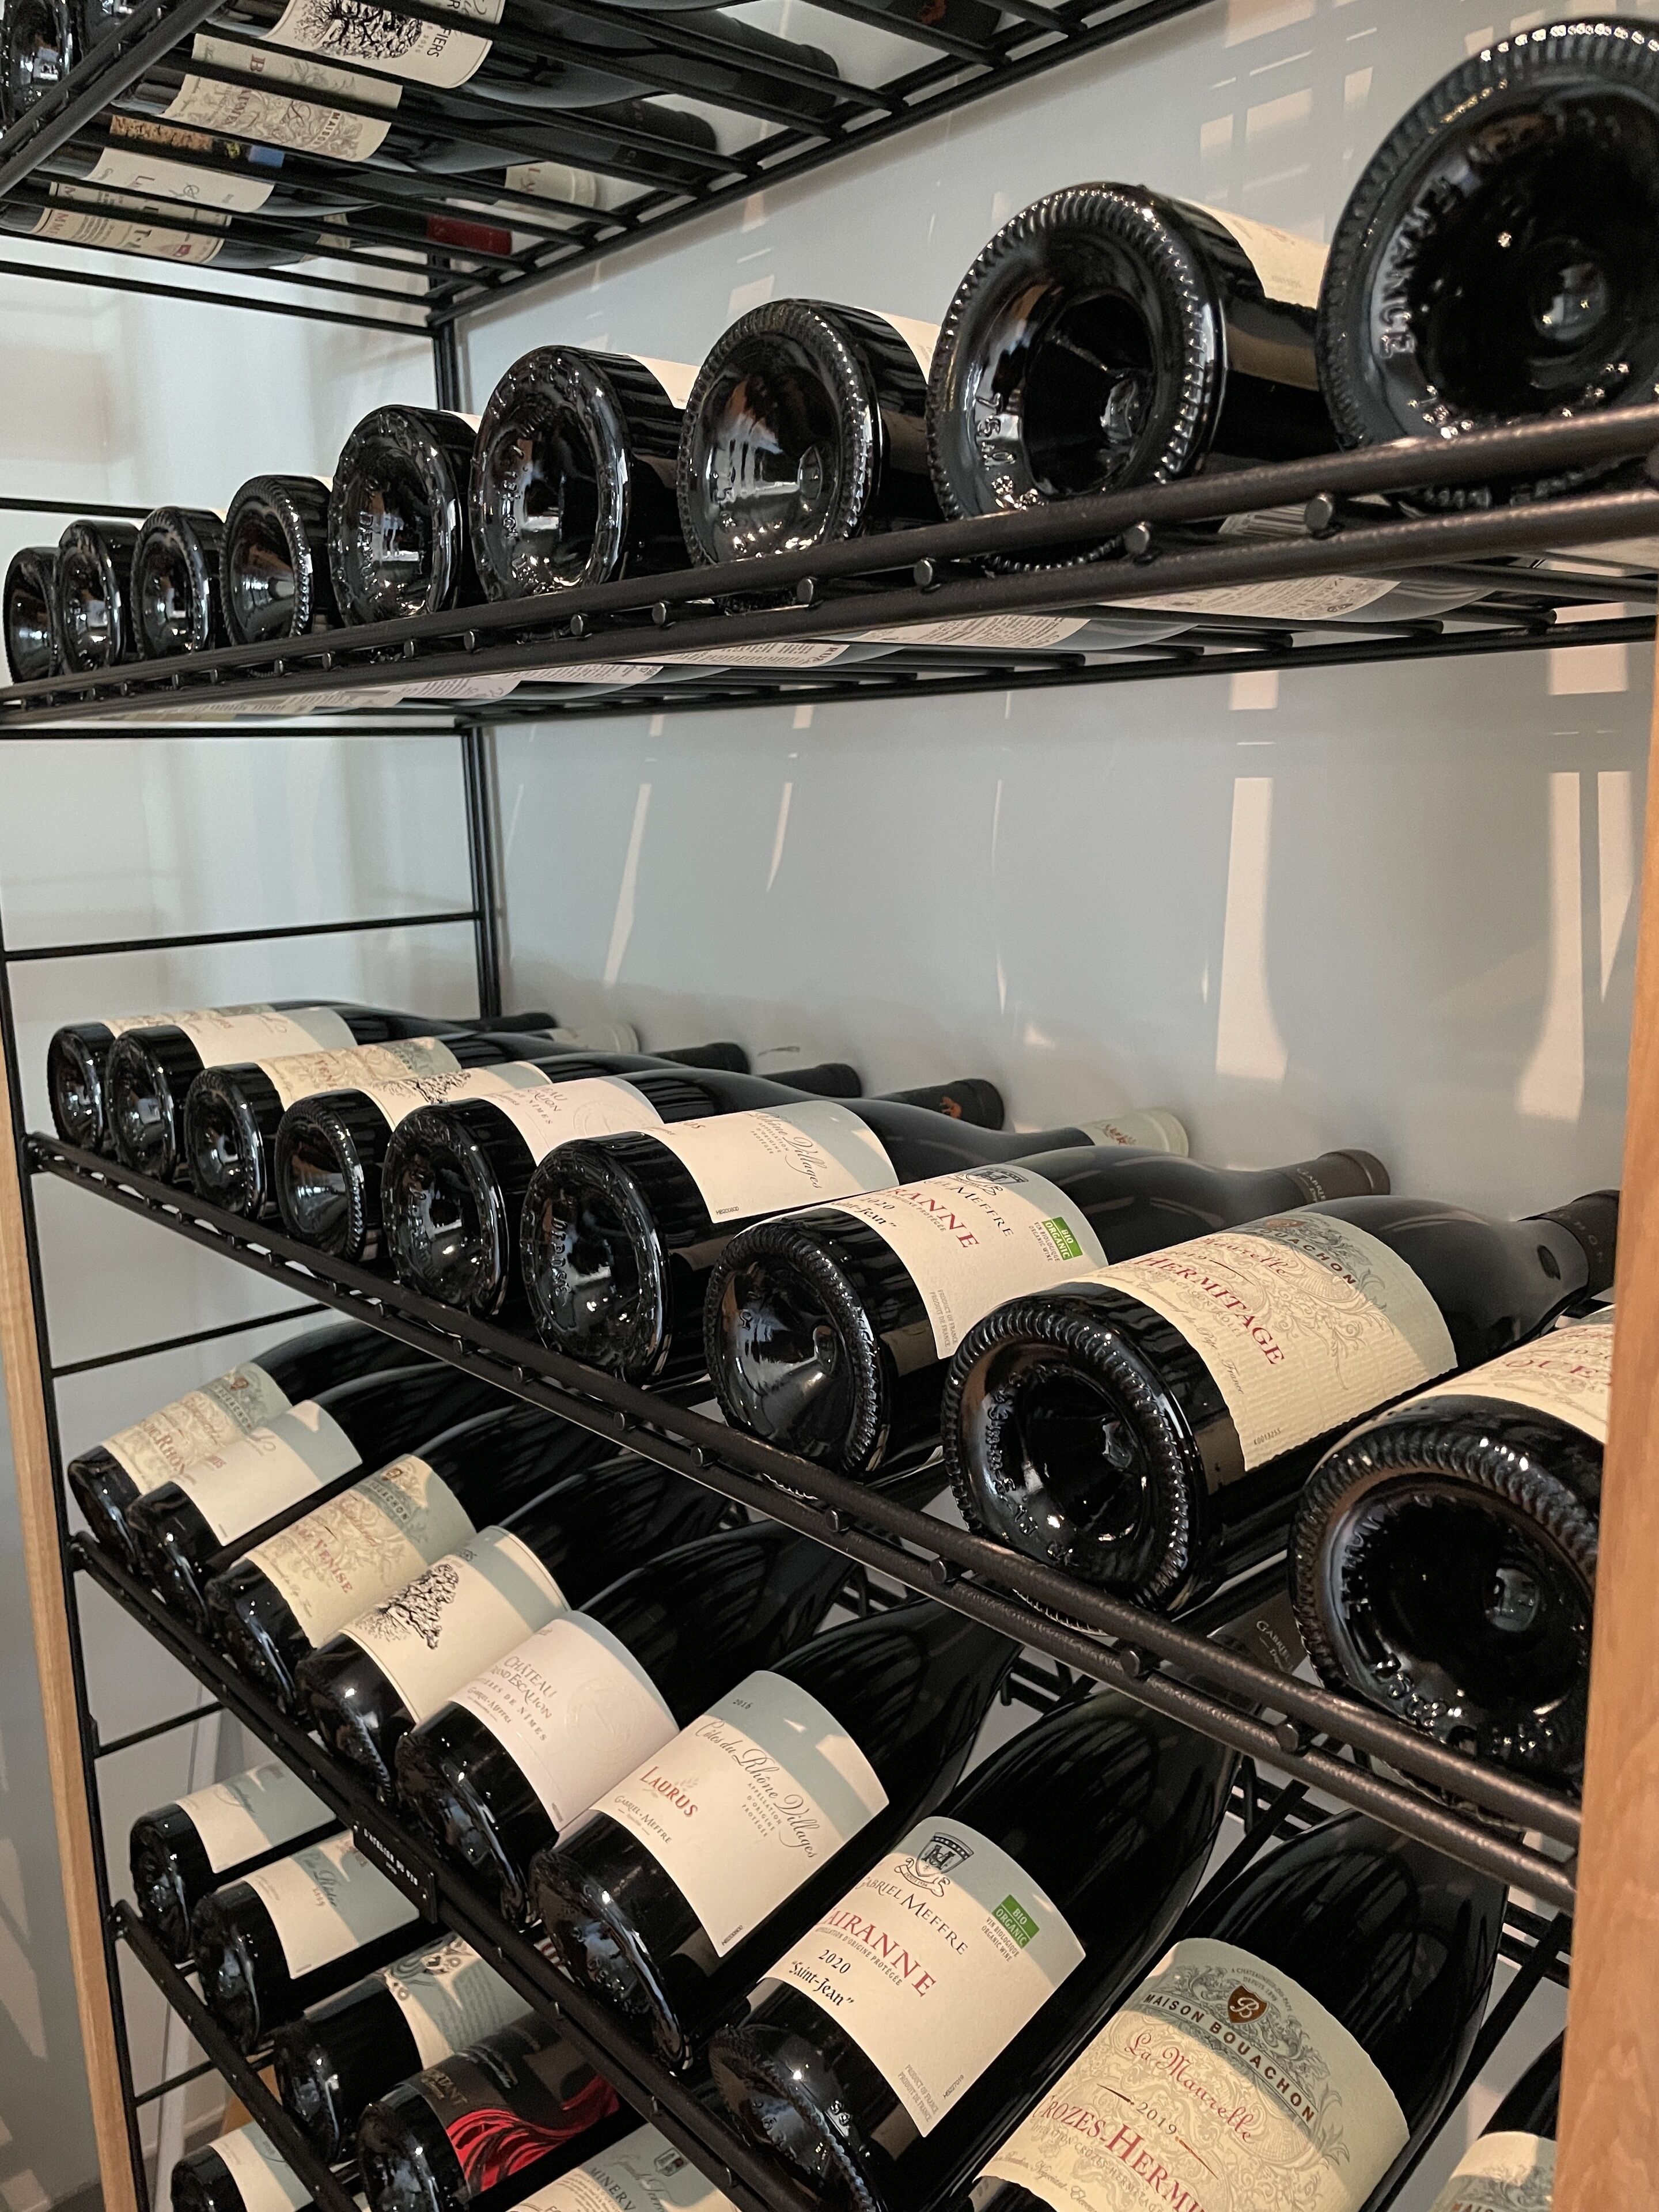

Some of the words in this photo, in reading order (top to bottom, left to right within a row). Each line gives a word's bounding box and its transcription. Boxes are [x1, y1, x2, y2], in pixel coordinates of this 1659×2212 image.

[783, 1137, 827, 1189] Villages
[888, 1188, 980, 1248] RANNE
[950, 1186, 1014, 1237] MEFFRE
[1028, 1225, 1046, 1247] ORGANIC
[1042, 1247, 1053, 1262] WINE
[1040, 1231, 1060, 1262] BIOLOGIQUE
[1045, 1222, 1070, 1259] ORGANIC
[1061, 1229, 1074, 1244] BIO
[1260, 1228, 1357, 1285] OUACHON
[503, 1656, 558, 1698] CHÂTEAU
[503, 1693, 517, 1706] DE
[517, 1706, 548, 1741] NIMES
[733, 1699, 753, 1710] 2016
[695, 1720, 725, 1744] Côtes
[719, 1740, 744, 1754] du
[639, 1766, 698, 1818] LAURUS
[731, 1748, 780, 1799] Rhône
[741, 1804, 768, 1838] PROTÉGÉE
[746, 1794, 775, 1831] D'ORIGINE
[747, 1782, 782, 1825] APPELLATION
[772, 1793, 820, 1858] Villages
[899, 1892, 968, 1956] MEFFRE
[986, 1916, 996, 1928] VIN
[994, 1926, 1020, 1957] BIOLOGIQUE
[995, 1908, 1028, 1946] ORGANIC
[1012, 1908, 1028, 1925] BIO
[817, 1949, 851, 1975] 2020
[822, 1907, 937, 1998] AIRANNE
[843, 1936, 872, 1958] D'ORIGINE
[870, 1954, 903, 1986] PROTÉGÉE
[981, 1925, 1002, 1949] ORGANIC
[999, 1946, 1013, 1962] WINE
[1143, 1993, 1205, 2023] MAISON
[1209, 2021, 1315, 2122] BOUACHON
[1124, 2032, 1152, 2061] La
[1155, 2046, 1255, 2144] Maurelle
[1137, 2102, 1177, 2135] 2019
[590, 2166, 636, 2211] MINERV
